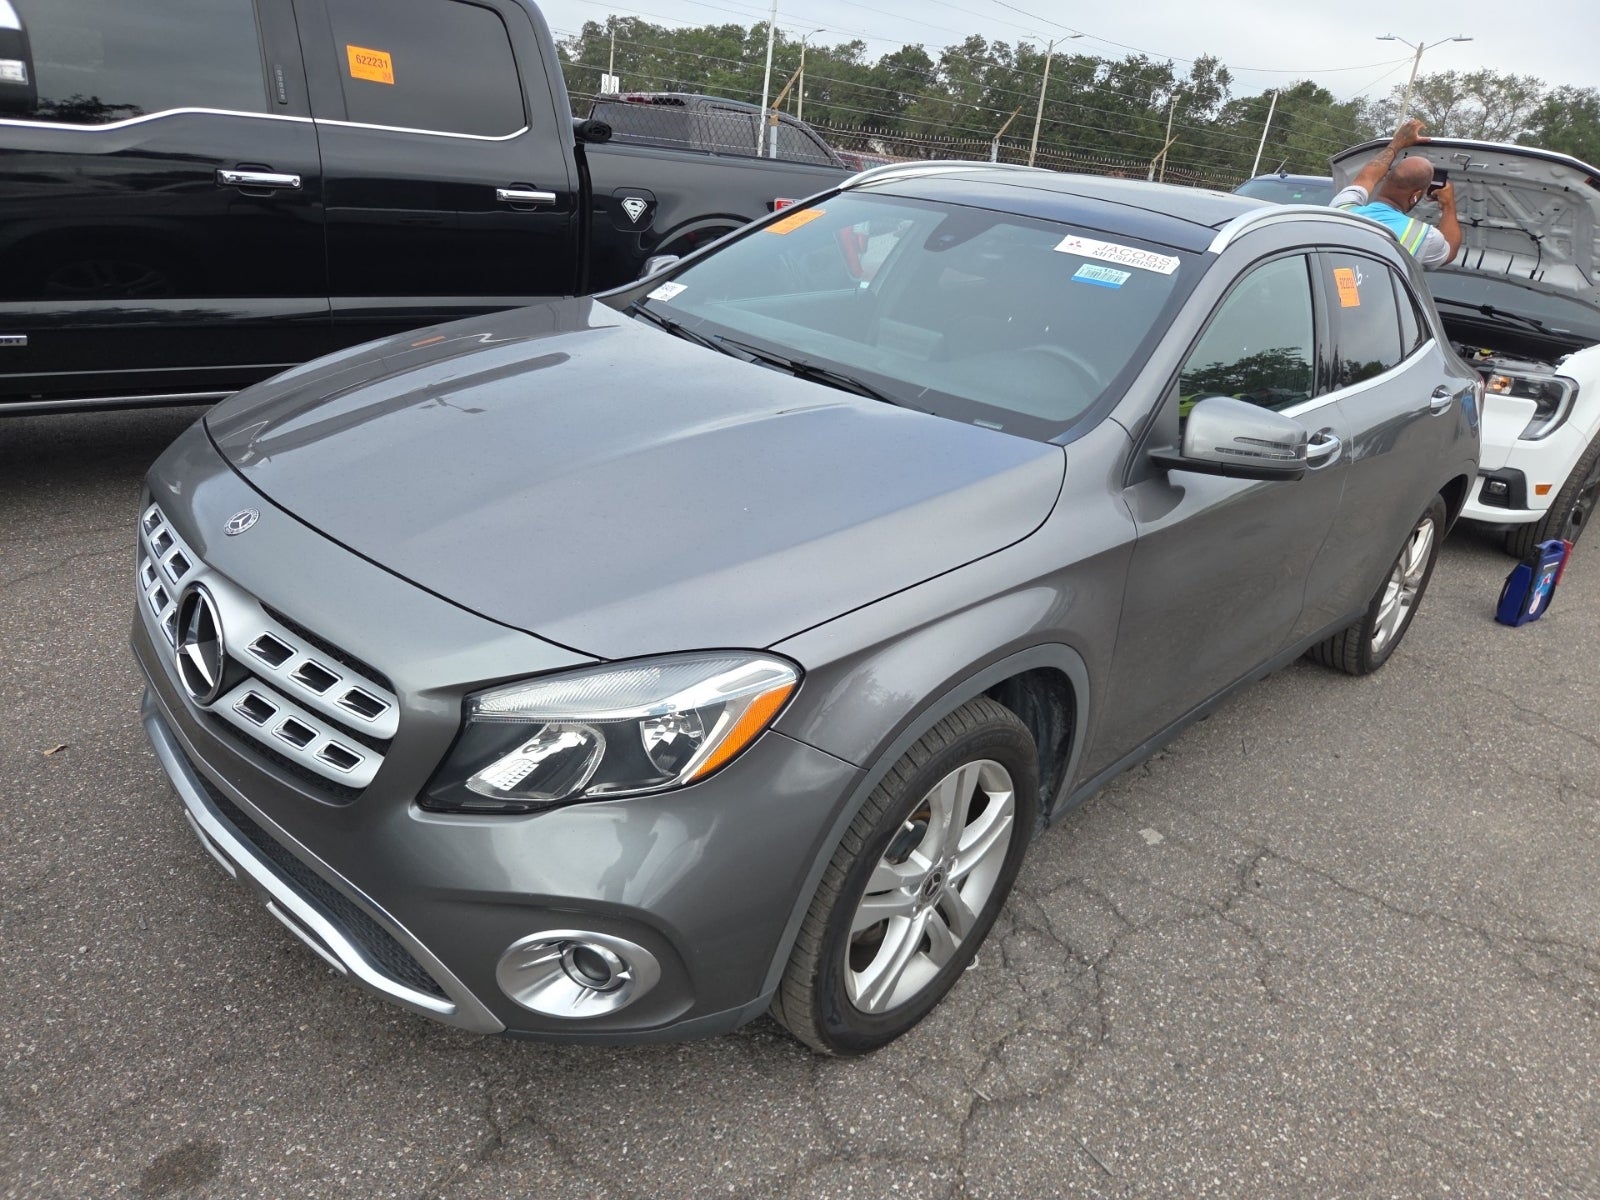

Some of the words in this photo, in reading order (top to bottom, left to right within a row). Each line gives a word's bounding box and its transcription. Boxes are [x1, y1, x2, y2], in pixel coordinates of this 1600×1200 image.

[355, 54, 388, 69] 622231
[1092, 250, 1166, 271] MITSUBISHI
[1097, 244, 1172, 266] JACOBS
